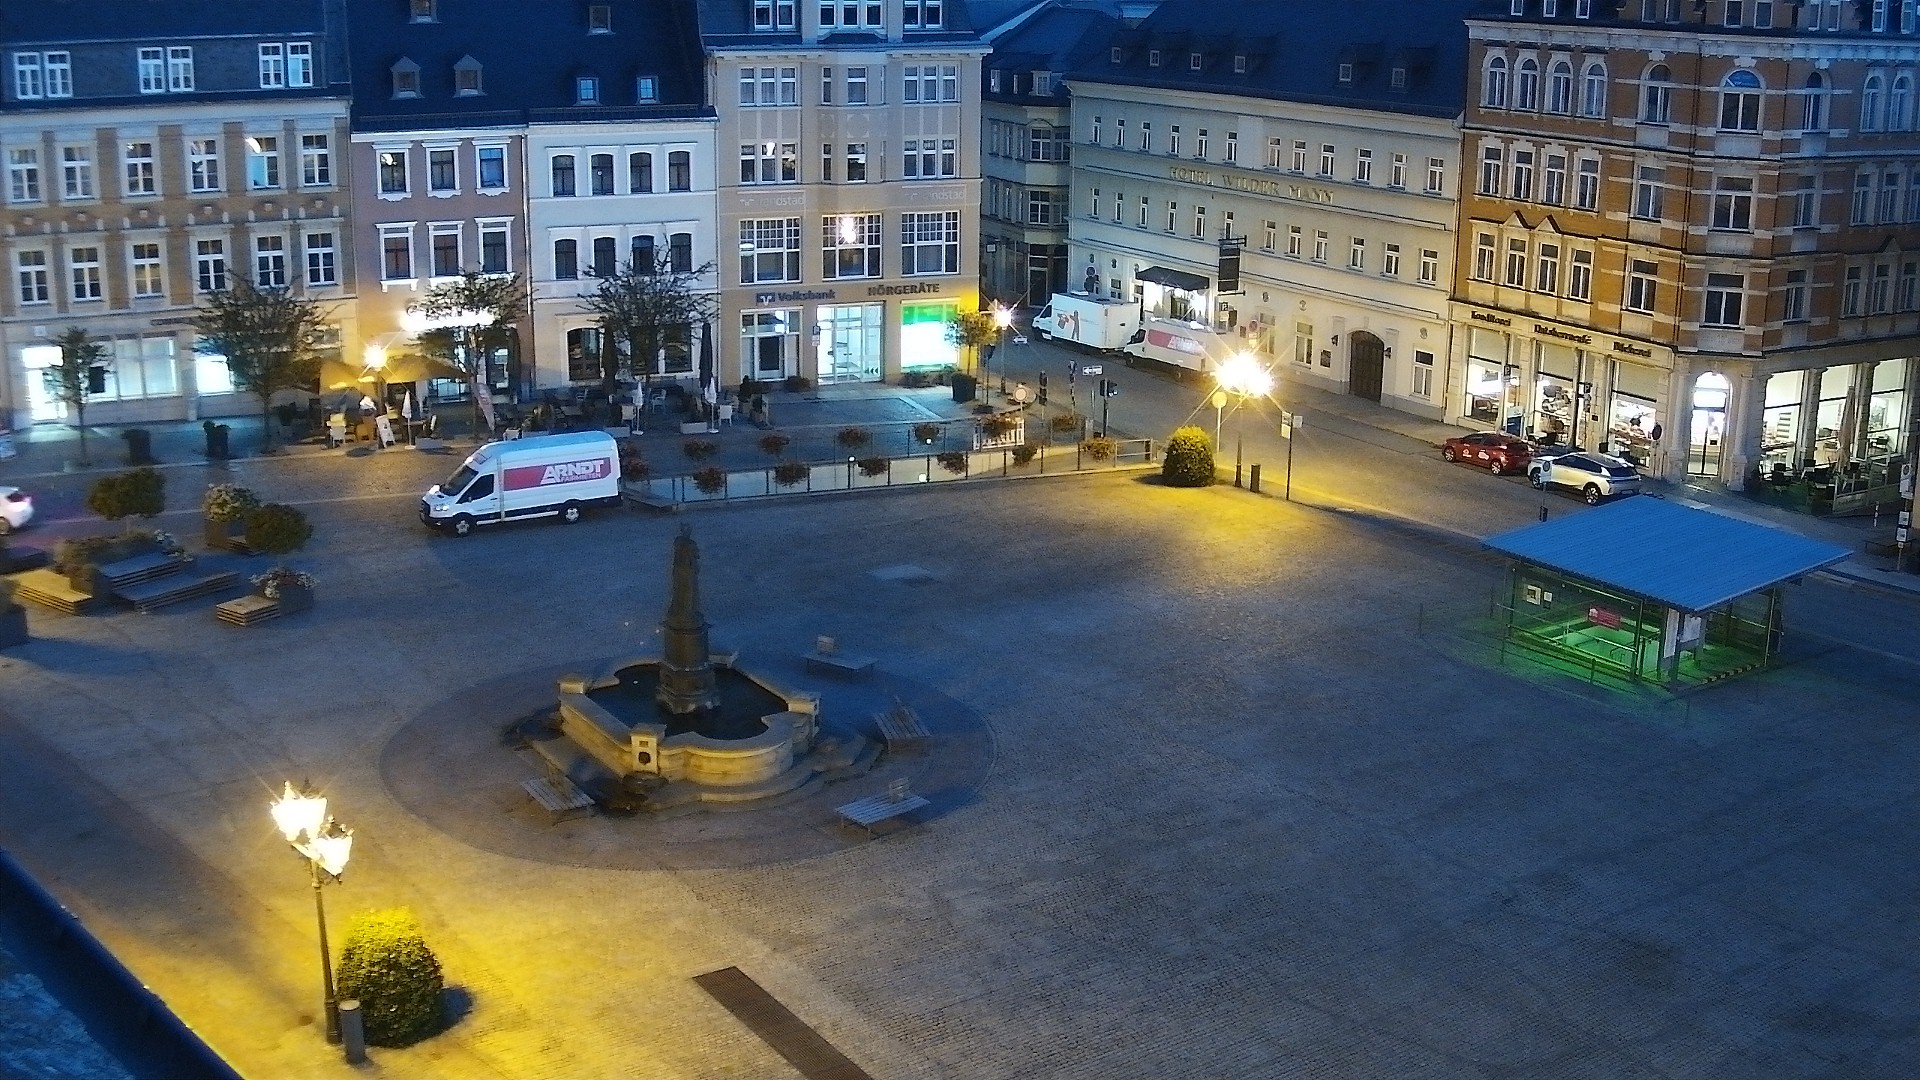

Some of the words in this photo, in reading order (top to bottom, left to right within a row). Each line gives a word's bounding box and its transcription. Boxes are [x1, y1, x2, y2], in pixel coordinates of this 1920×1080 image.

[1170, 166, 1214, 186] HOTEL
[1222, 174, 1280, 196] WILDER
[1288, 184, 1334, 204] MANN
[778, 289, 836, 302] Volksbank
[868, 283, 940, 297] HÖRGERÄTE
[540, 460, 604, 485] ARNDT
